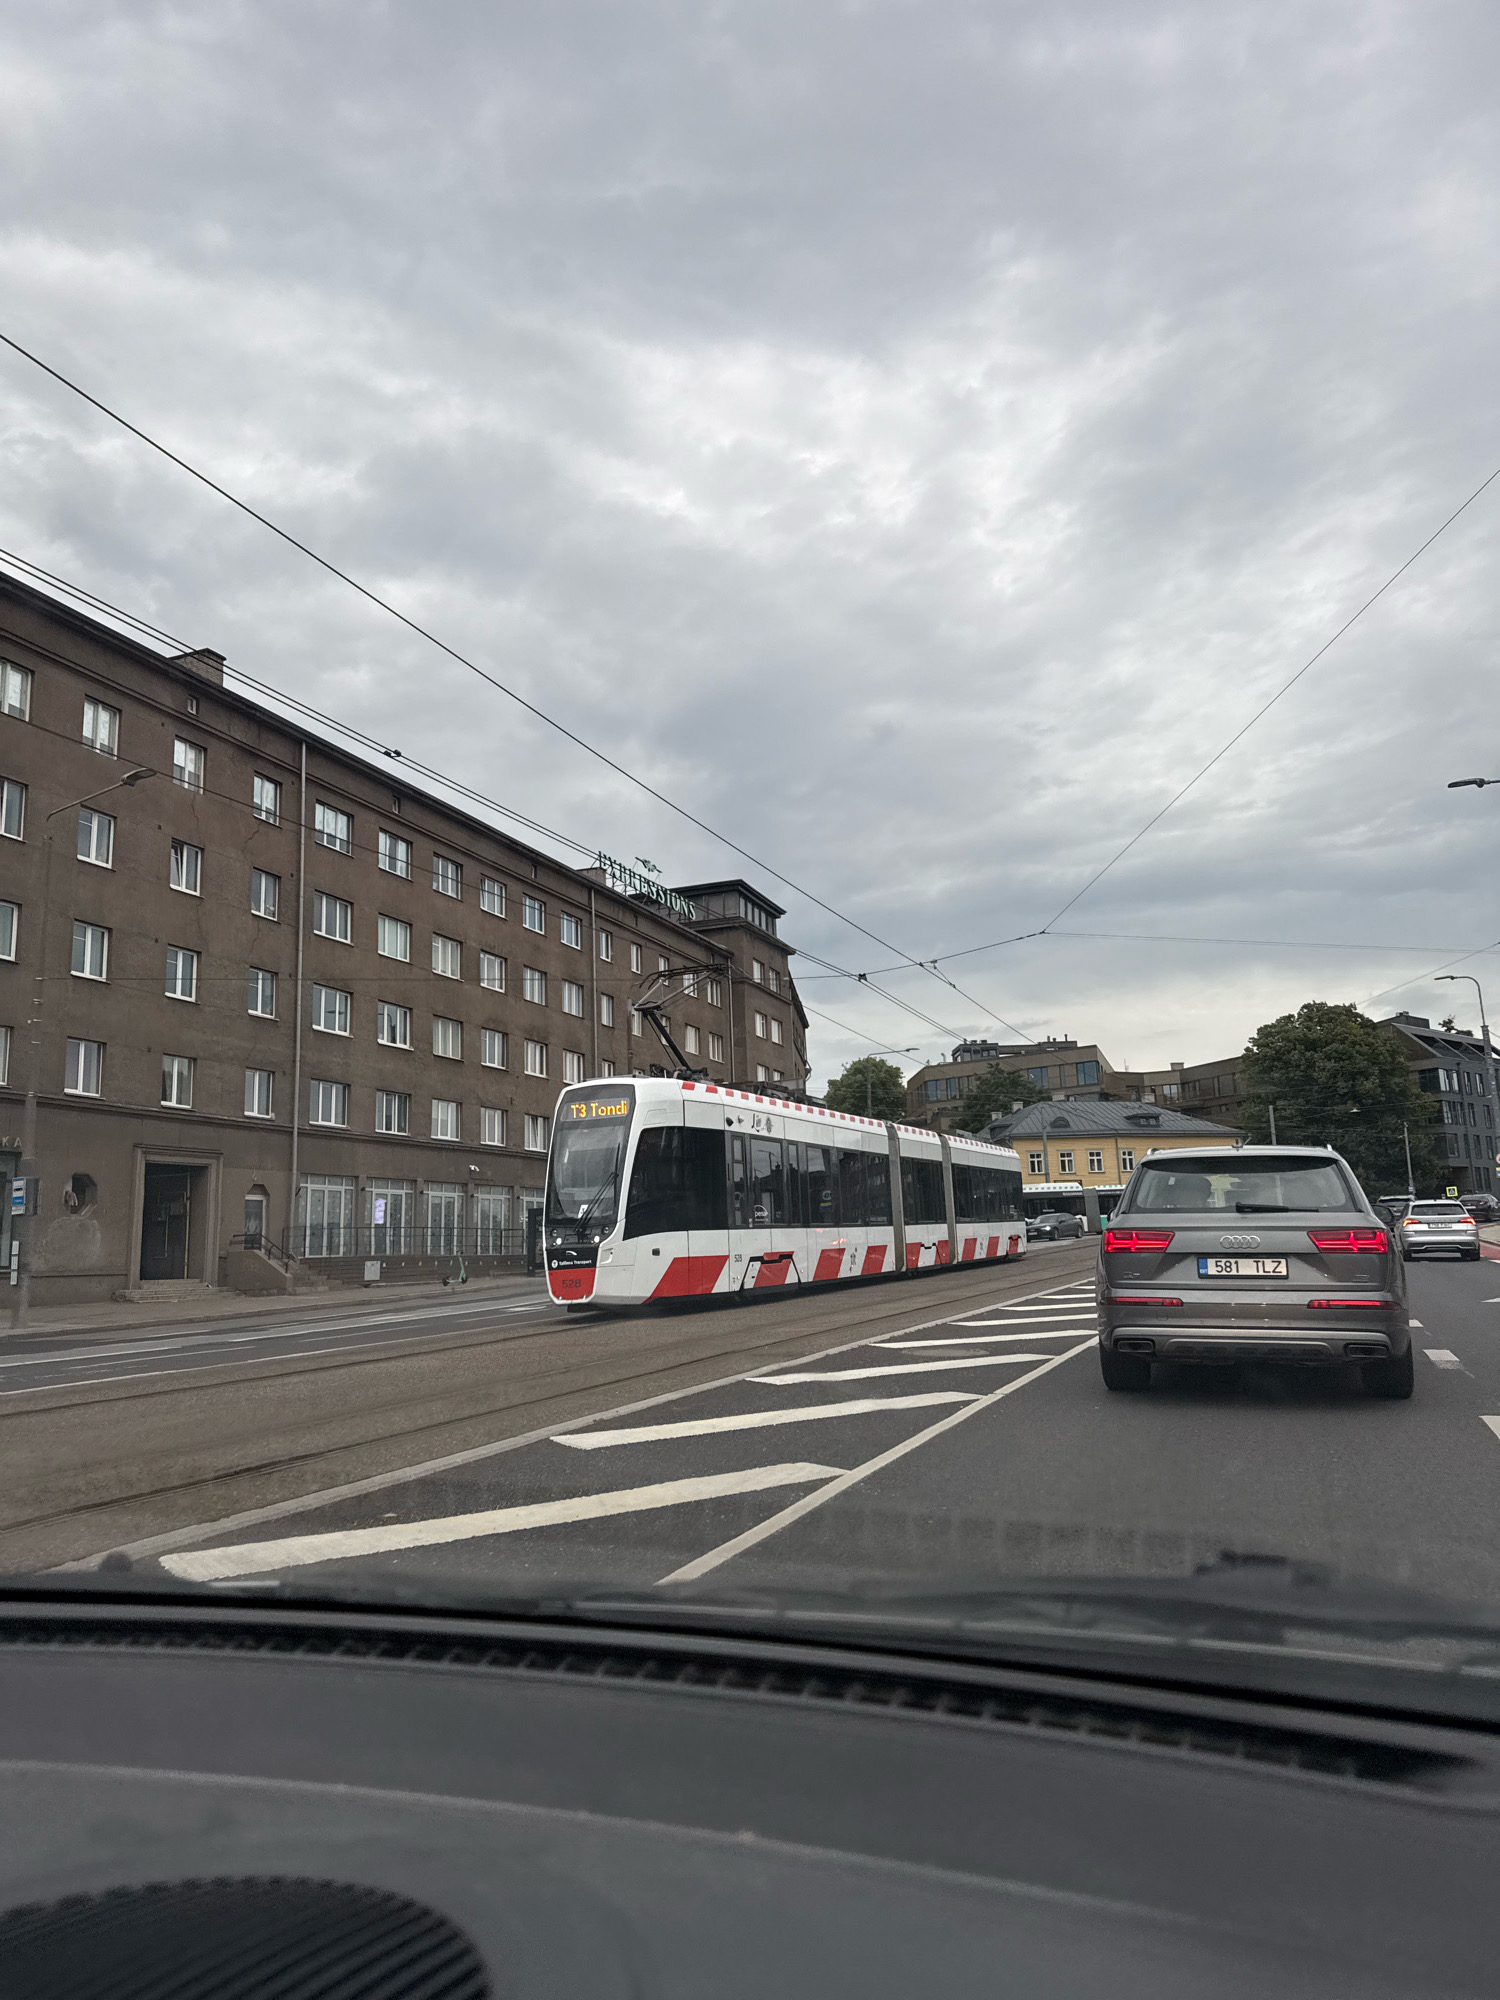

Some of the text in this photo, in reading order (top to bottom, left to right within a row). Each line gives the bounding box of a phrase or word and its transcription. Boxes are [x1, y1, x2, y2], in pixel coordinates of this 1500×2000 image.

[571, 1100, 627, 1118] T3 Tondi
[1214, 1260, 1283, 1274] 581 TLZ
